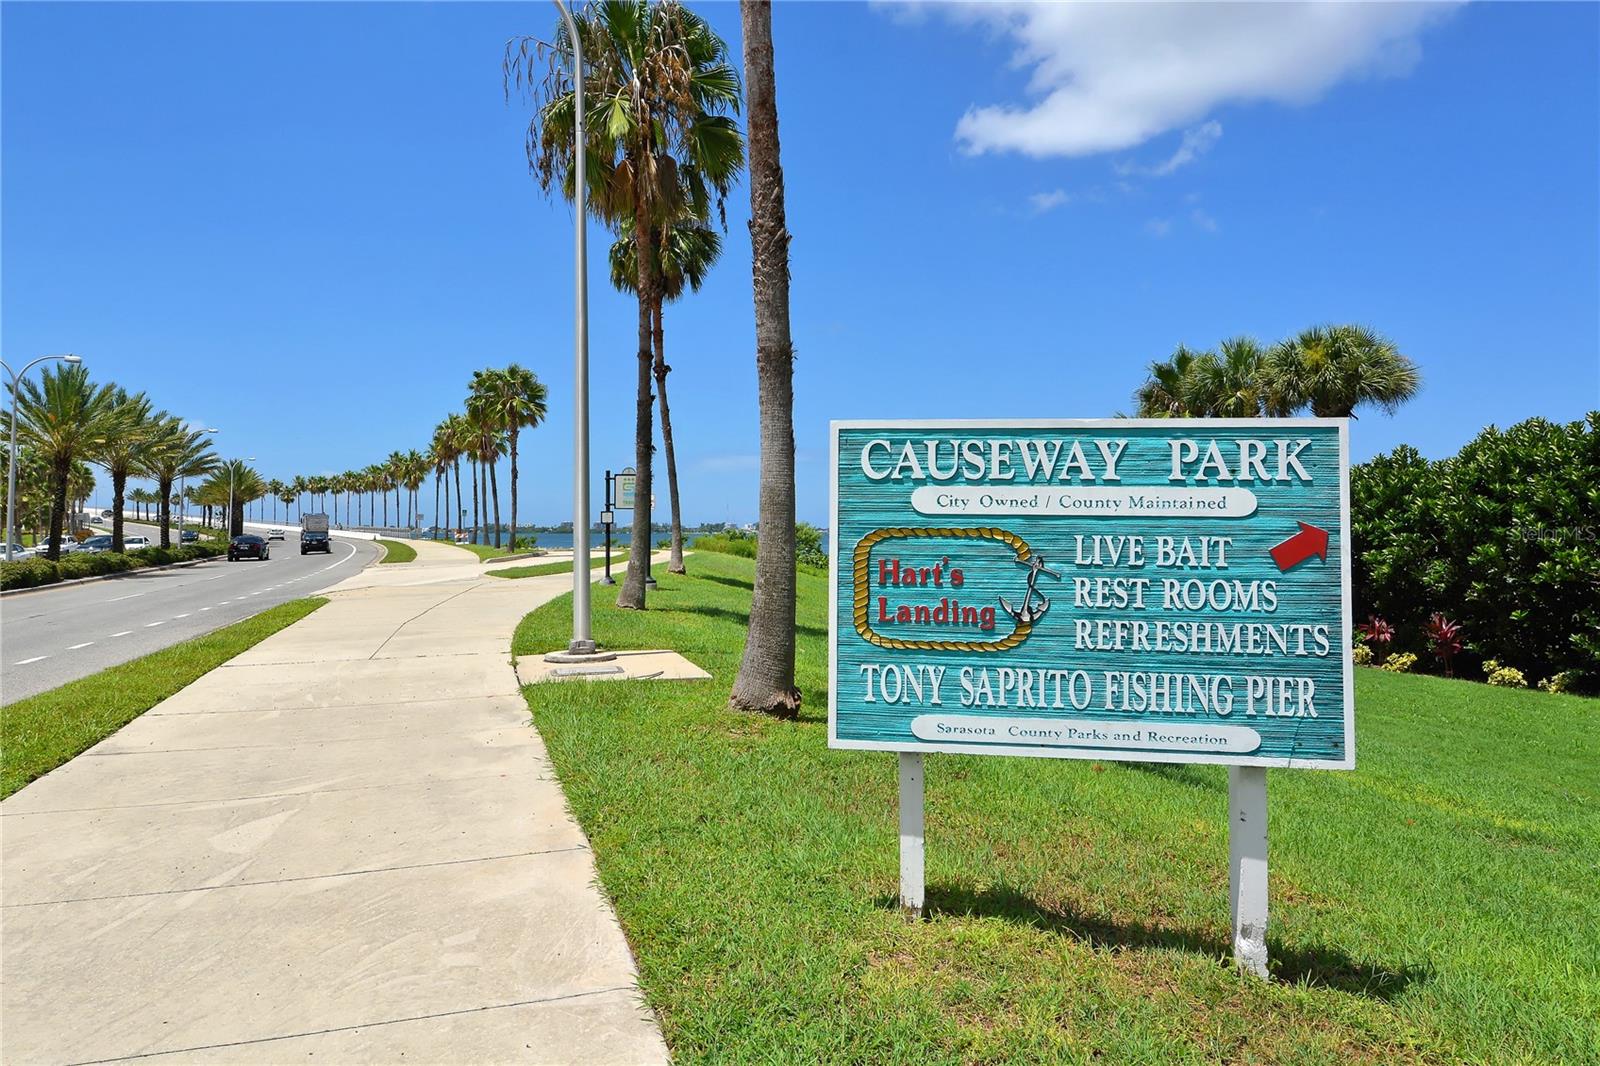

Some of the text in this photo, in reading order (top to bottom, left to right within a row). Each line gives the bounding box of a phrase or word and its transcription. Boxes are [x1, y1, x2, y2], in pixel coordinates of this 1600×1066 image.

[861, 440, 1313, 481] CAUSEWAY PARK
[937, 494, 970, 510] City
[980, 494, 1038, 508] Owned
[1059, 495, 1122, 512] County
[1128, 495, 1227, 510] Maintained
[1073, 535, 1232, 567] LIVE BAIT
[878, 556, 964, 585] Hart's
[1072, 577, 1278, 612] REST ROOMS
[878, 596, 996, 630] Landing
[1073, 619, 1330, 657] REFRESHMENTS
[860, 664, 1319, 718] TONY SAPRITO FISHING PIER
[936, 723, 1228, 746] Sarasota County Parks and Recreation
